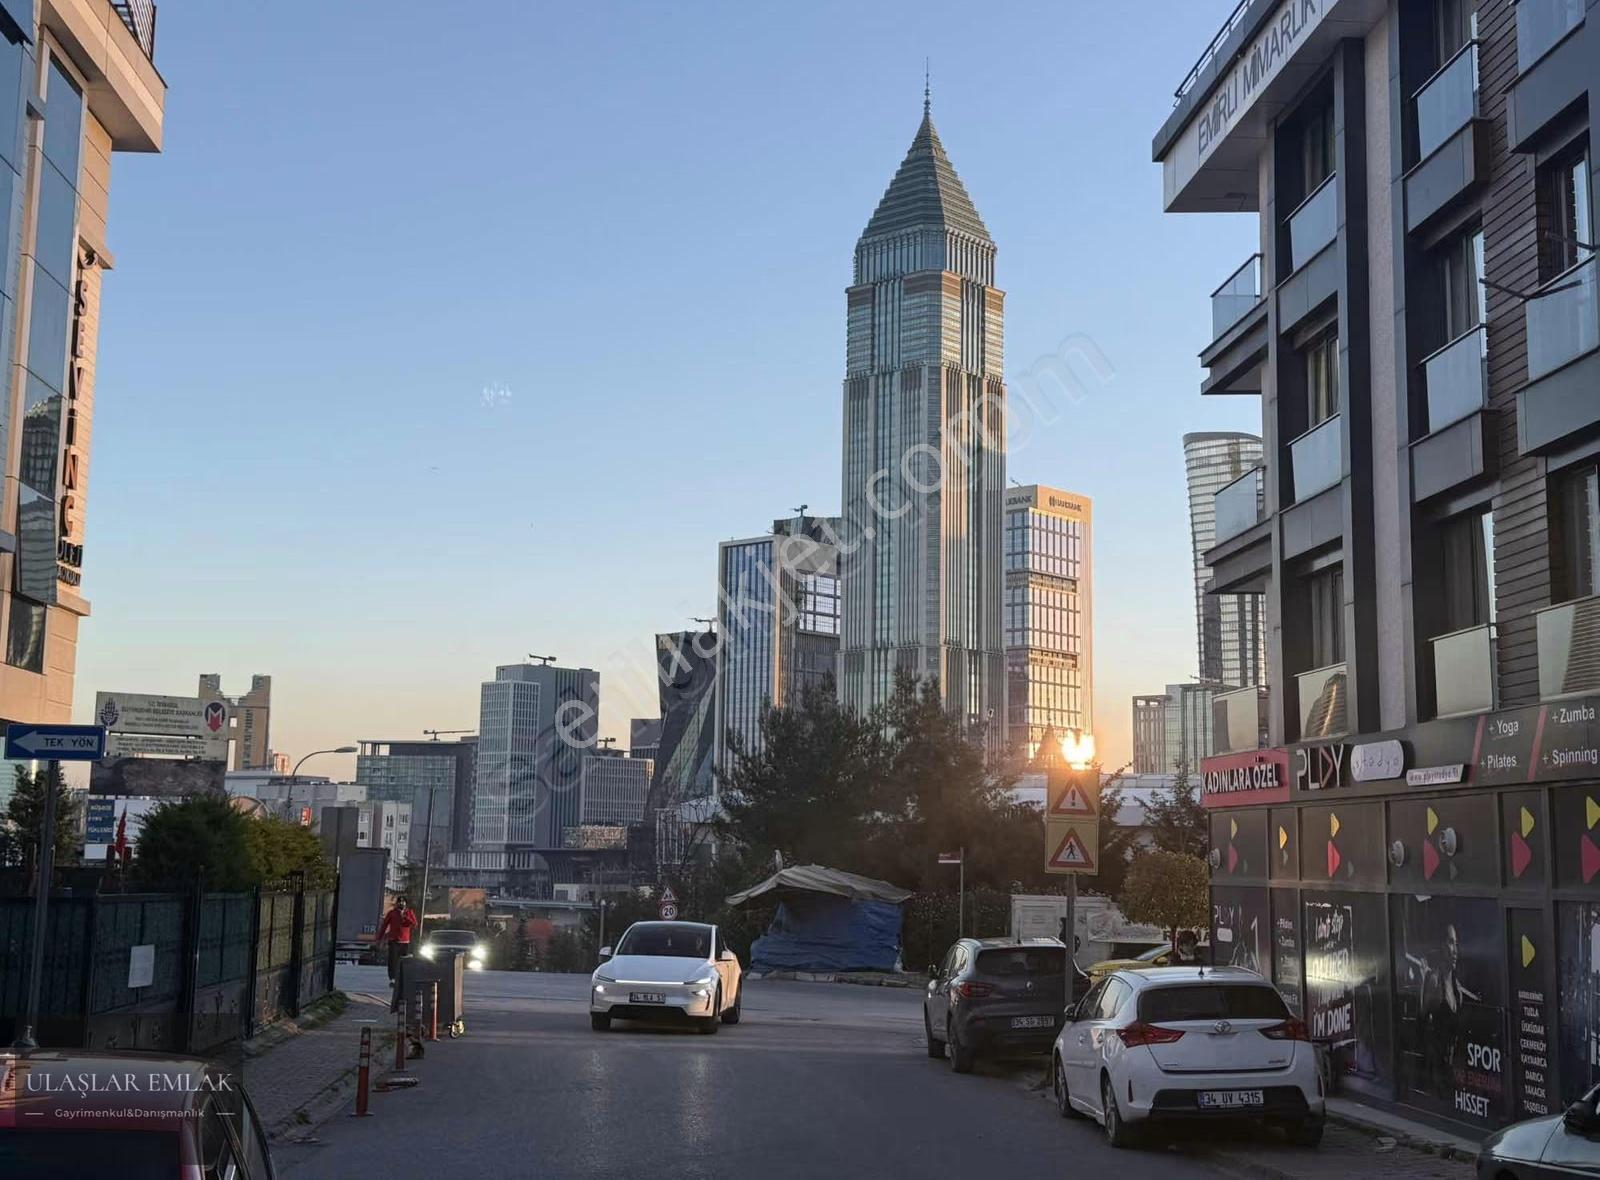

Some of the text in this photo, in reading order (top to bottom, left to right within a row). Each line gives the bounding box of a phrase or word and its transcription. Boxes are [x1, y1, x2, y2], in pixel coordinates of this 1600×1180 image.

[1198, 70, 1238, 157] EMİRLİ
[1559, 704, 1595, 724] Zumba
[1496, 720, 1519, 736] Yoga
[43, 736, 95, 748] TEK YÖN
[1487, 754, 1517, 769] Pilates
[1552, 745, 1598, 767] Spinning
[1202, 766, 1252, 795] KADINLARA
[664, 907, 674, 916] 20
[1327, 1003, 1351, 1036] DONE
[1467, 1042, 1501, 1073] SPOR
[1204, 1092, 1217, 1105] 34
[1238, 1090, 1261, 1104] 4315
[1455, 1088, 1490, 1118] HİSSET
